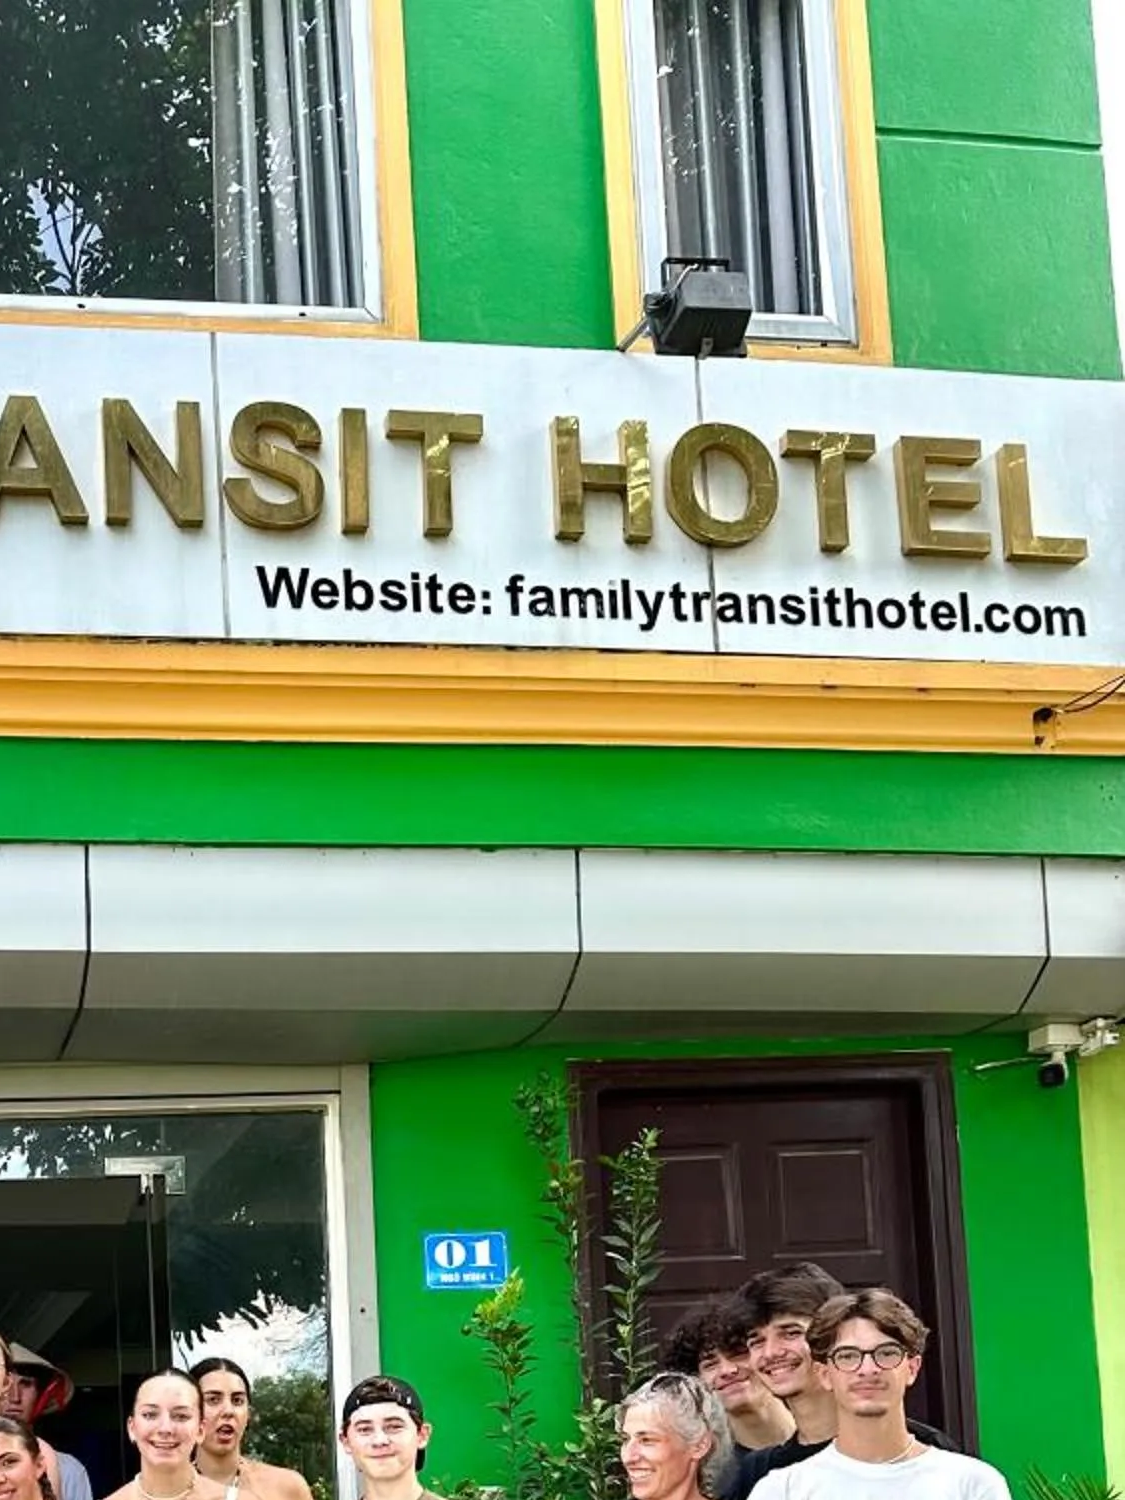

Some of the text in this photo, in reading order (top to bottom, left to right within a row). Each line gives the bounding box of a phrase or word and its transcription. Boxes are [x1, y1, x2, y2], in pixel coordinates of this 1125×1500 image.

[548, 415, 1088, 564] HOTEL
[255, 565, 1088, 637] Website: familytransithotel.com
[434, 1238, 498, 1269] 01
